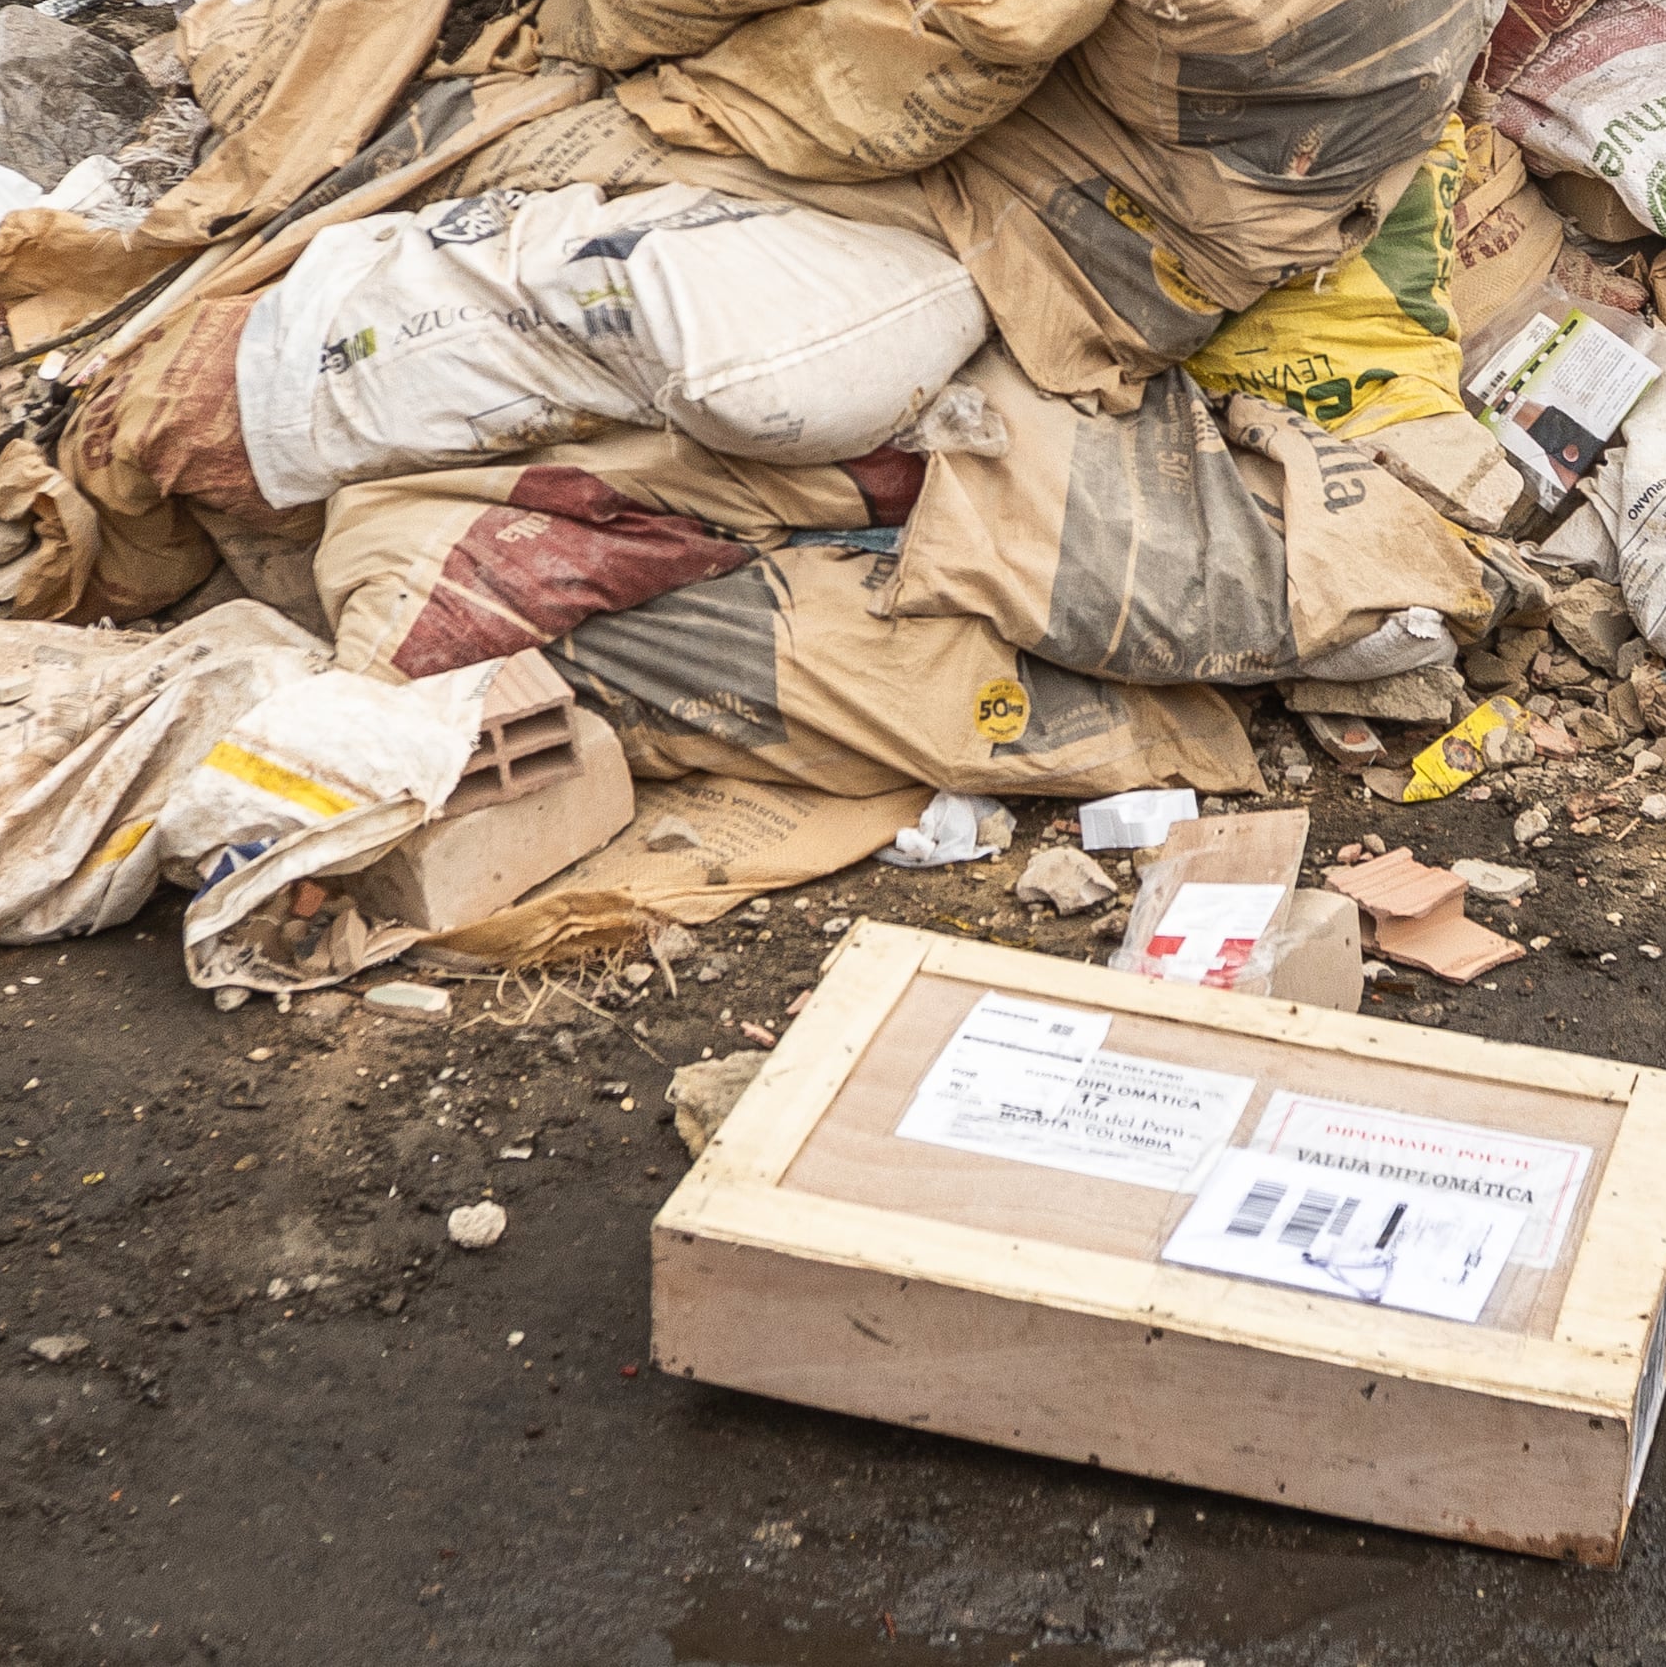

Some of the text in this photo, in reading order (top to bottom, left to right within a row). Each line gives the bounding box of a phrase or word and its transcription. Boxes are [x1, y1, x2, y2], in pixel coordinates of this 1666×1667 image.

[978, 693, 1023, 721] 50kg
[1076, 1077, 1202, 1111] DIPLOMÁTICA
[1080, 1093, 1110, 1108] 17
[1085, 1125, 1173, 1152] COLOMBIA
[1325, 1123, 1445, 1156] DIPLOMATIC
[1297, 1147, 1535, 1204] VALIJA DIPLOMÁTICA
